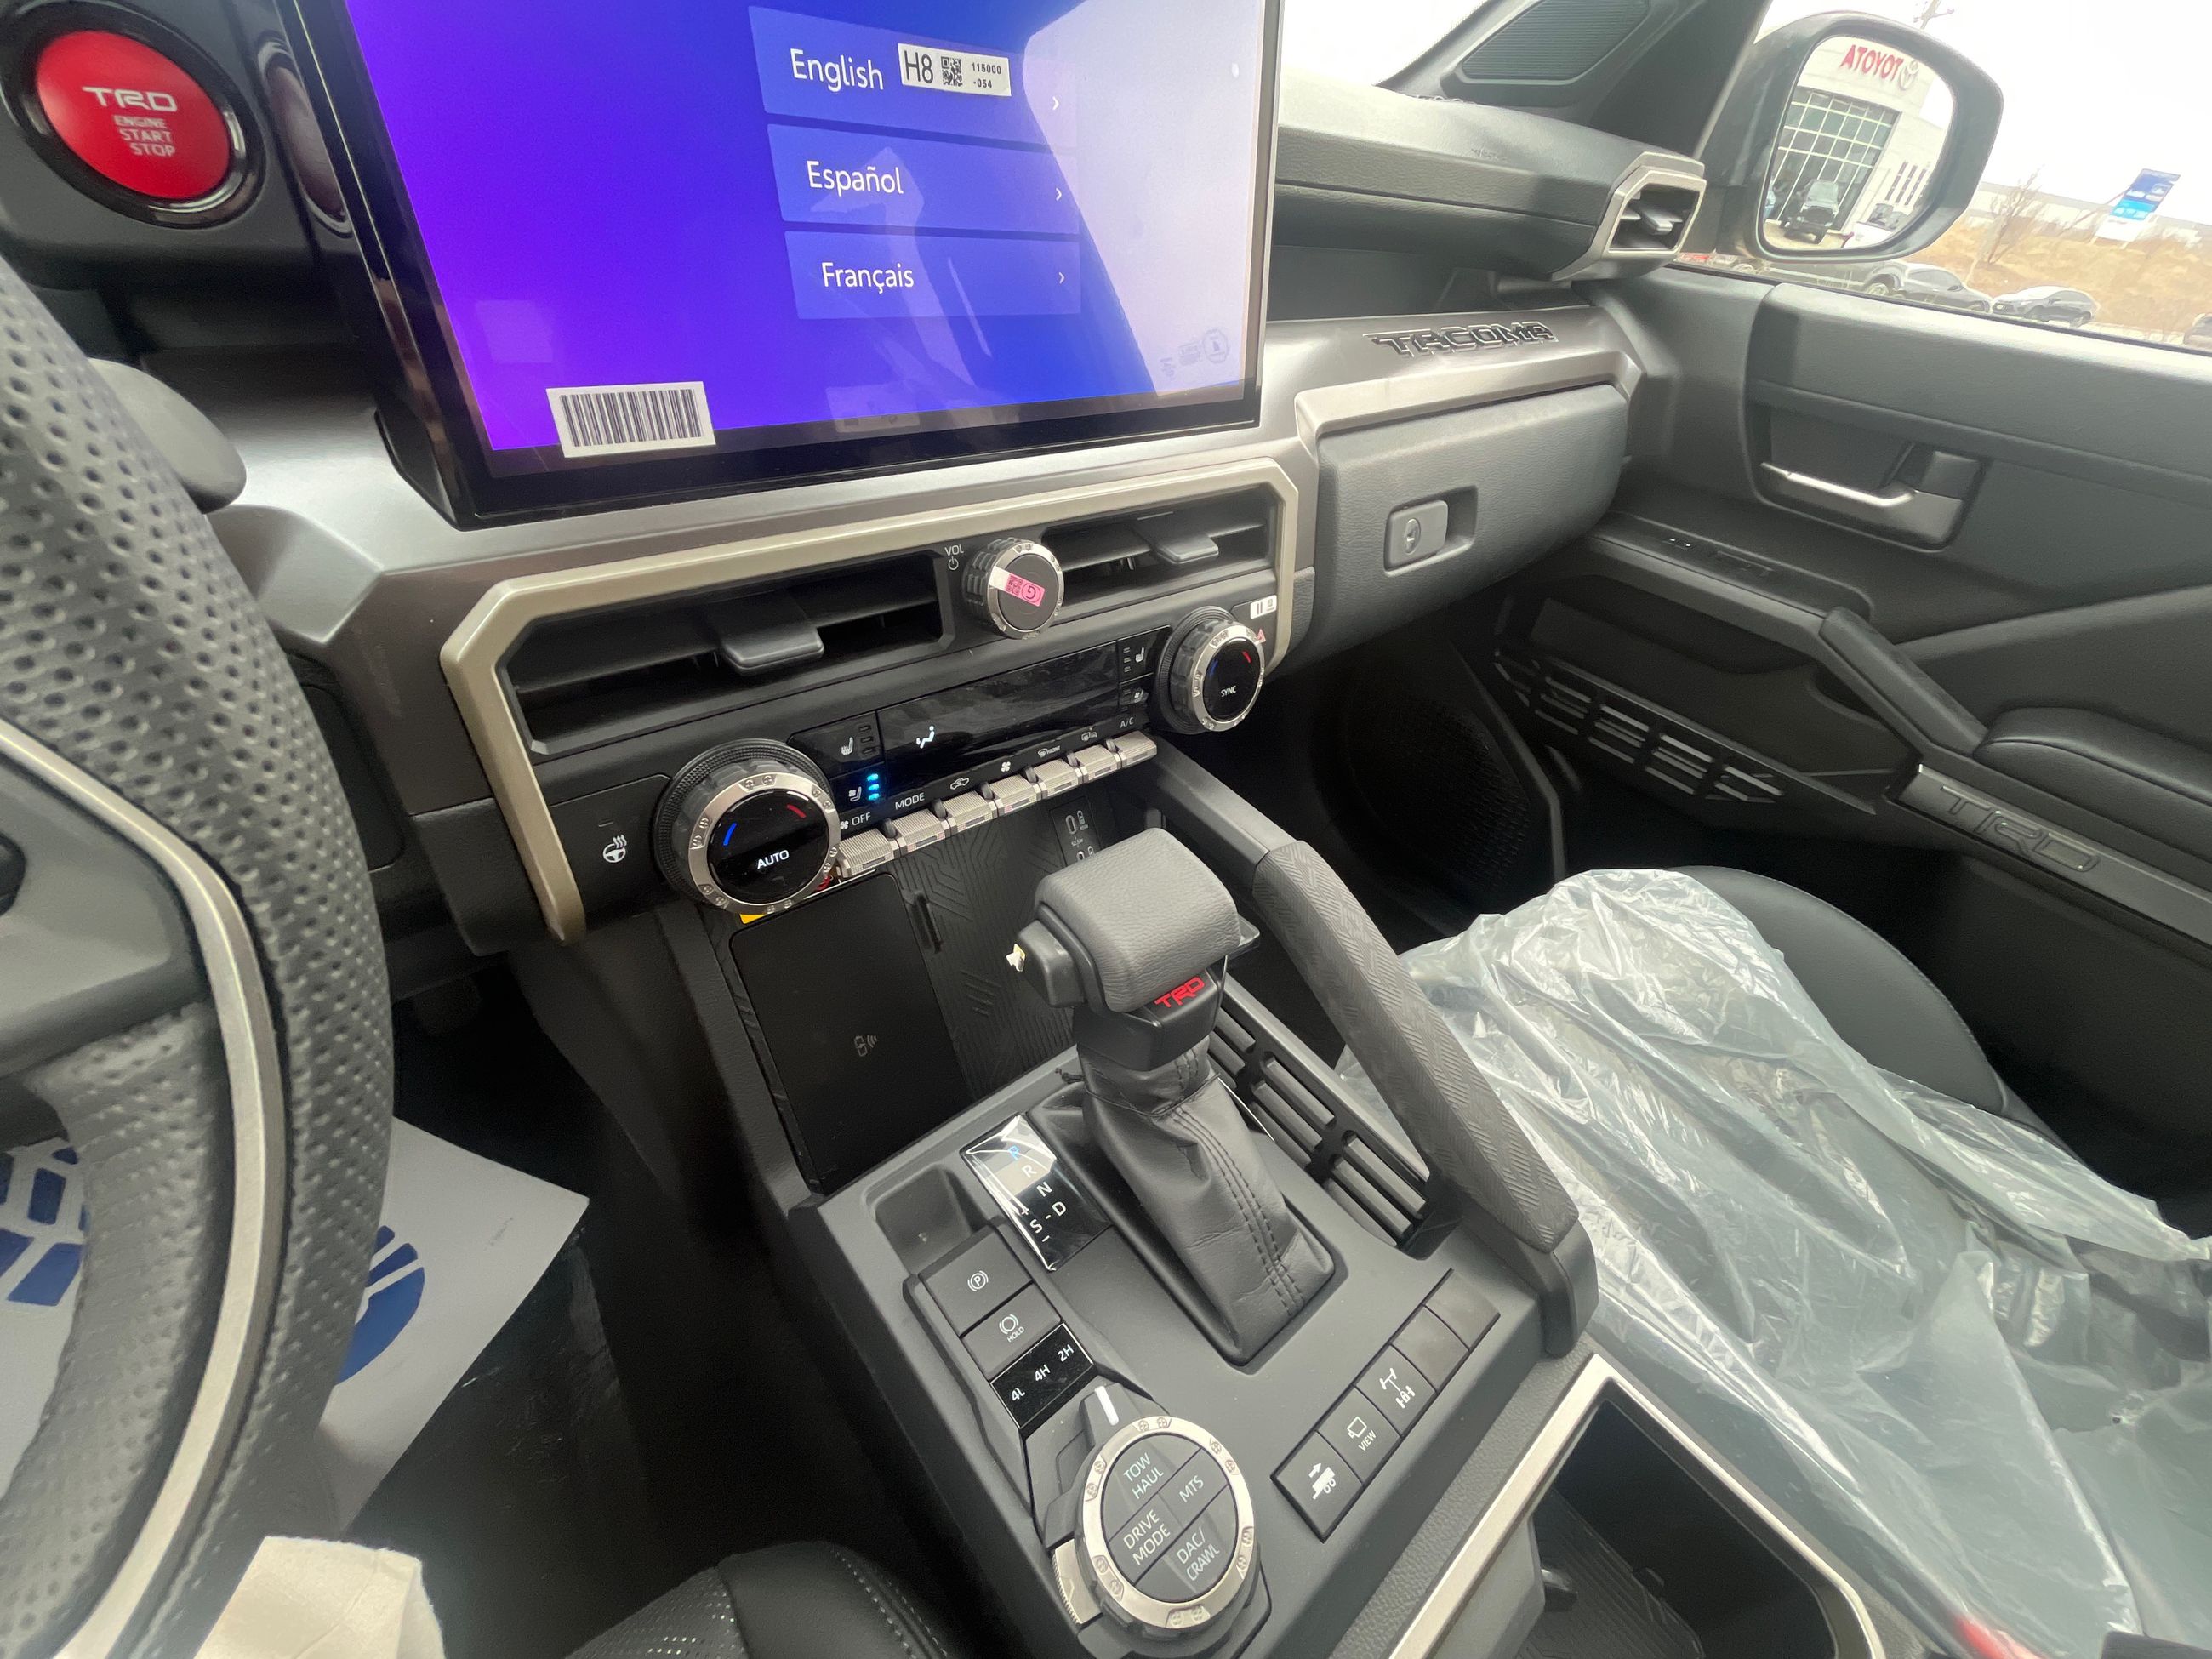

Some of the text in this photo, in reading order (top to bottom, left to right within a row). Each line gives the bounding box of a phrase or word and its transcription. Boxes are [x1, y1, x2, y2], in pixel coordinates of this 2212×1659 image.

[790, 48, 884, 92] English
[904, 50, 934, 83] H8
[972, 62, 1002, 76] 115000
[82, 86, 178, 112] TRD
[112, 115, 168, 129] ENGINE
[118, 128, 173, 143] START
[129, 141, 175, 157] STOP
[807, 160, 904, 197] Español
[821, 262, 915, 294] Français
[1363, 321, 1559, 357] TACOMA
[944, 544, 964, 556] VOL
[1220, 685, 1237, 698] SYNC
[1120, 717, 1134, 729] A/C
[895, 792, 926, 810] MODE
[852, 812, 871, 826] OFF
[756, 849, 790, 869] AUTO
[1154, 975, 1206, 1008] TRD
[1022, 1164, 1037, 1178] R
[1036, 1181, 1052, 1197] N
[1006, 1326, 1025, 1343] HOLD
[1057, 1344, 1075, 1362] 2H
[1035, 1364, 1051, 1382] 4H
[1011, 1387, 1026, 1402] 4L
[1358, 1429, 1377, 1451] VIEW
[1123, 1451, 1152, 1483] TOW
[1132, 1467, 1165, 1500] HAUL
[1178, 1475, 1205, 1503] MTS
[1123, 1508, 1160, 1550] DRIVE
[1132, 1524, 1172, 1566] MODE
[1177, 1527, 1206, 1565] DAC/
[1186, 1543, 1221, 1582] CRAWL
